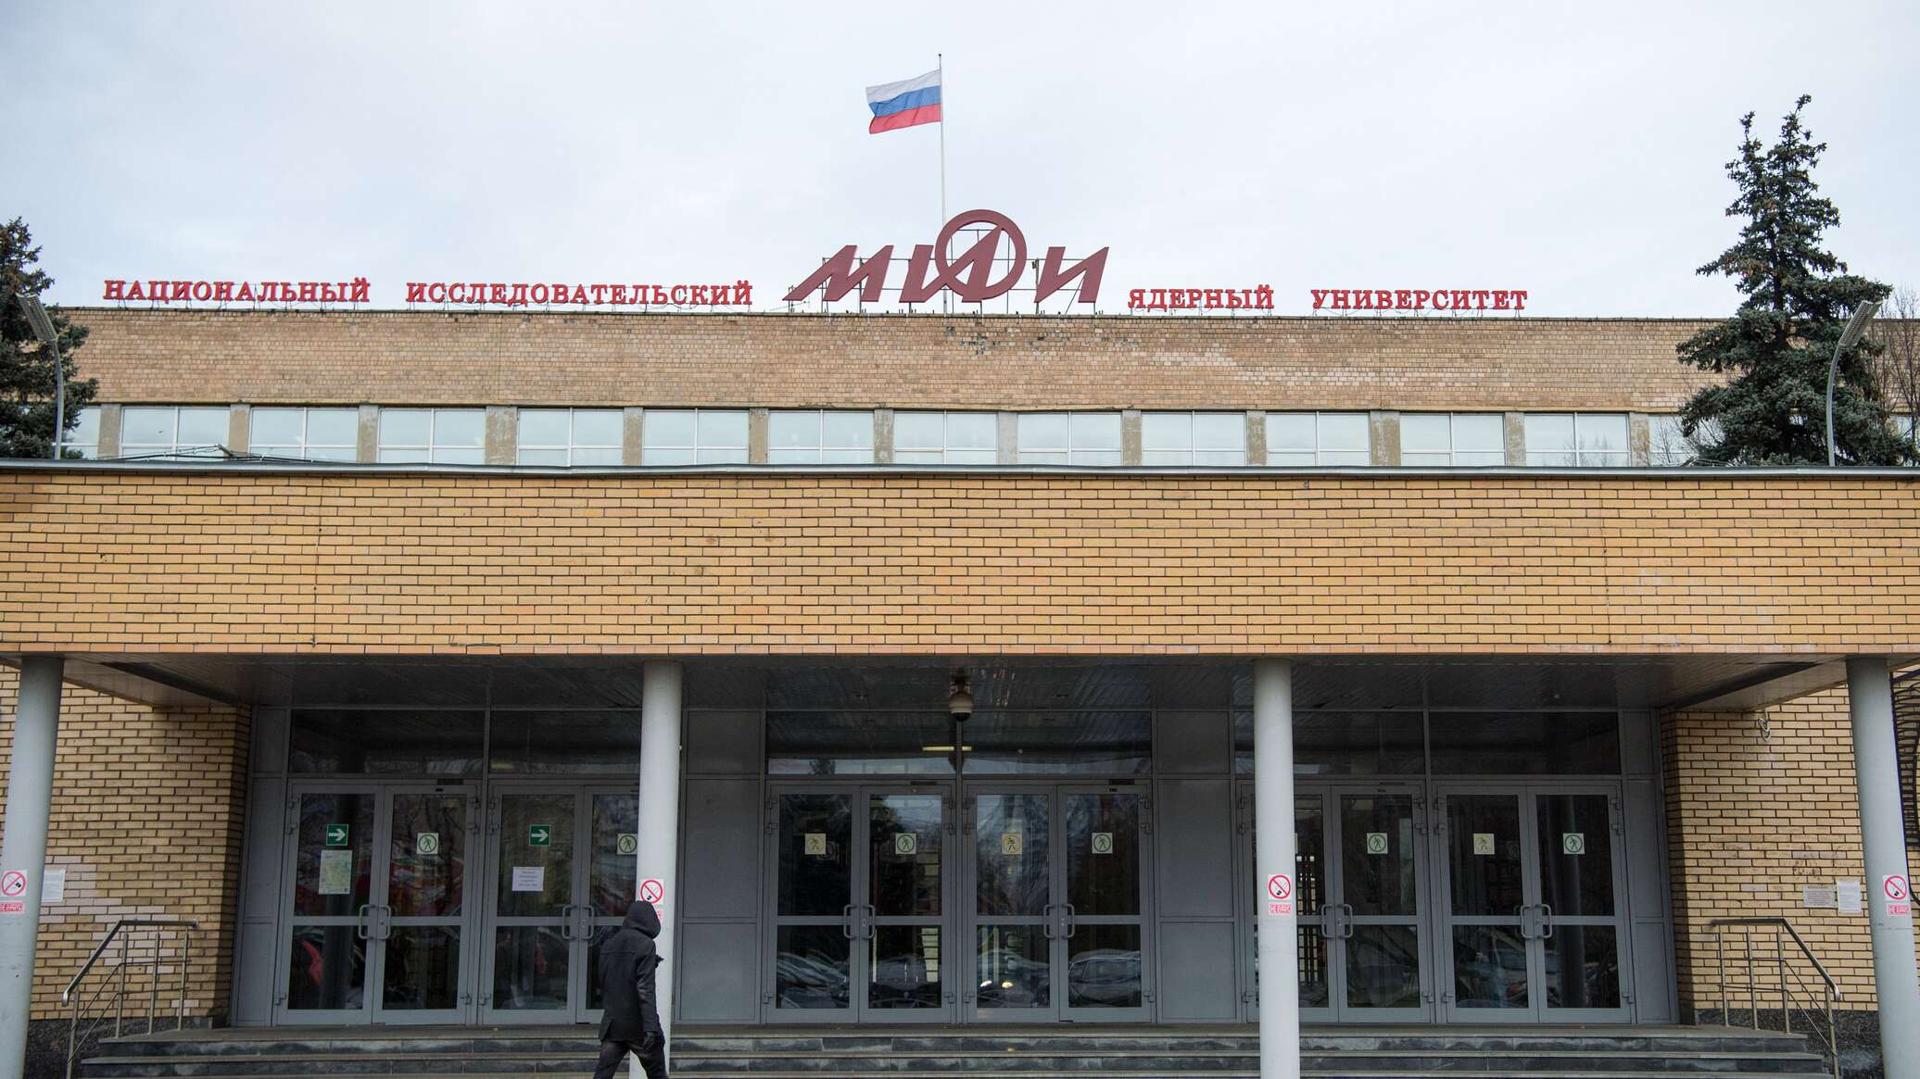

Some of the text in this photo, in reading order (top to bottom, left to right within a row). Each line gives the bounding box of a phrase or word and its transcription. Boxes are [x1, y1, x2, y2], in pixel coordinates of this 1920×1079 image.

[104, 277, 753, 307] НАЦИОНАЛЬНЫЙ ИССЛЕДОВАТЕЛЬСКИЙ
[1127, 284, 1528, 311] ЯДЕРНЫЙ УНИВЕРСИТЕТ
